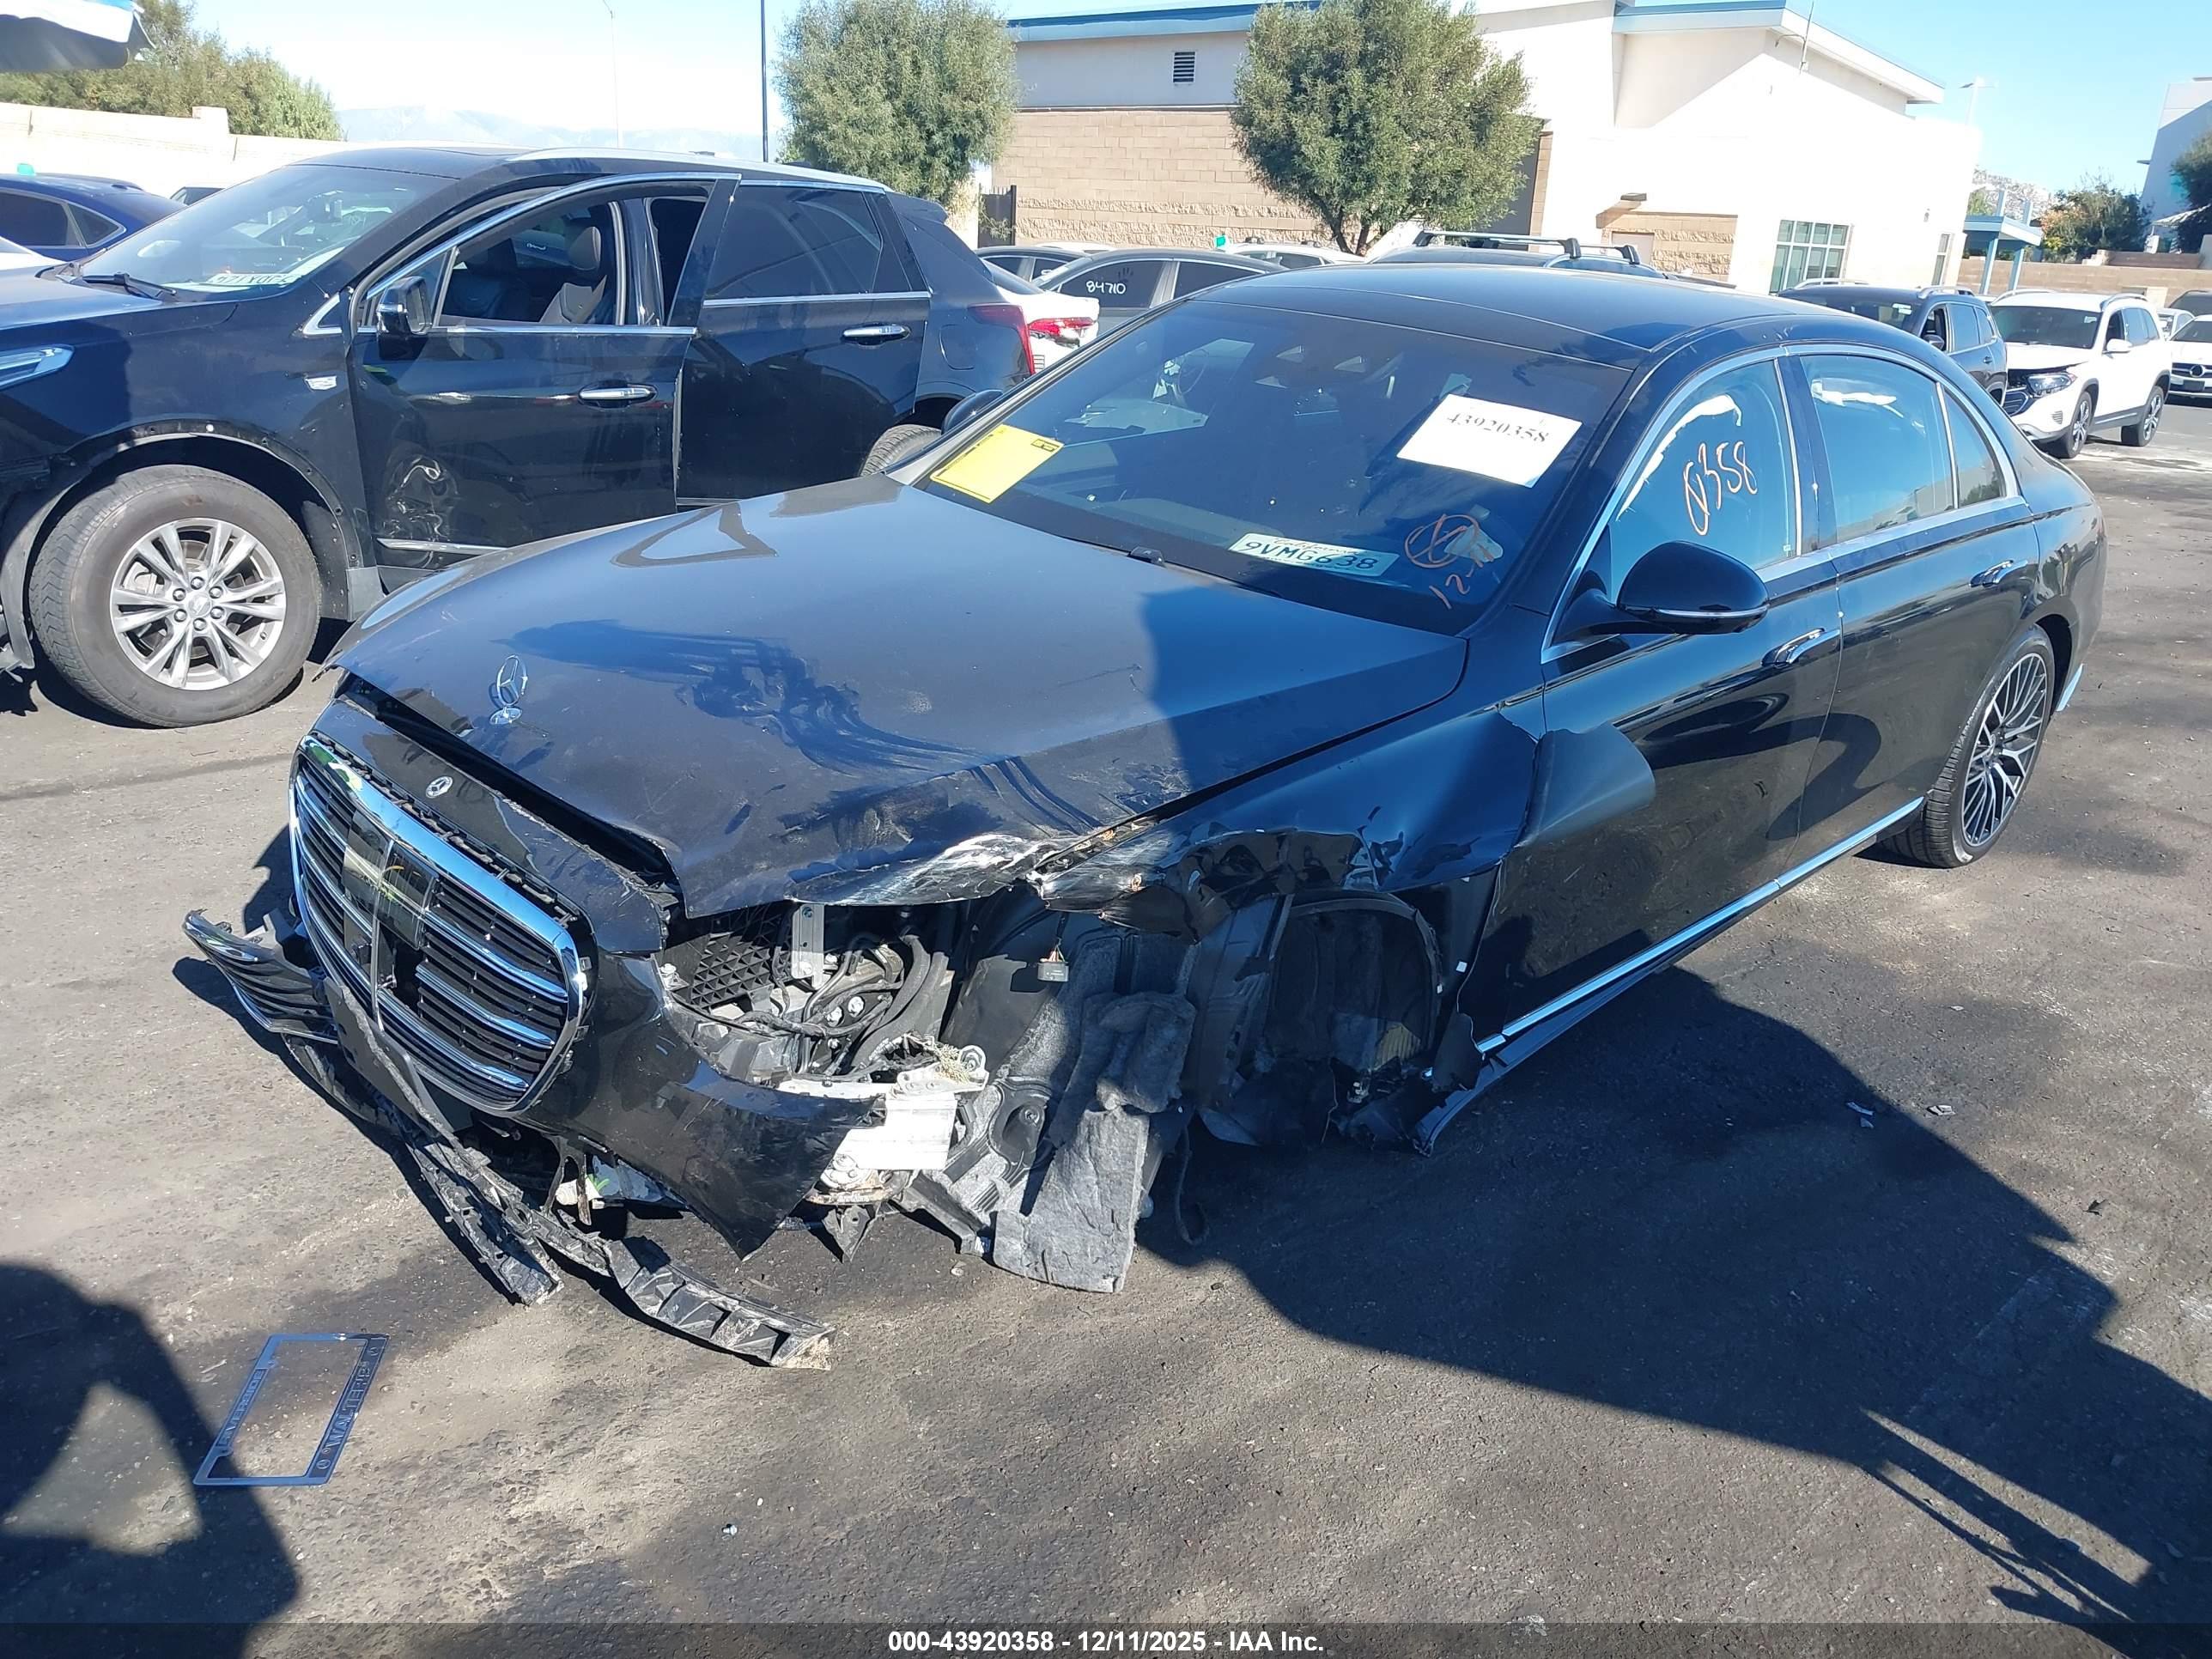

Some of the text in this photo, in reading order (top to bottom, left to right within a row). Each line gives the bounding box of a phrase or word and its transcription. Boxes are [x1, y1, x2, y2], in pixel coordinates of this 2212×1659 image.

[1085, 280, 1127, 295] 84710
[1447, 412, 1549, 443] 43920358
[1239, 540, 1378, 571] 9VMG638
[1273, 538, 1360, 556] California
[218, 1368, 264, 1447] RIVERSIDE
